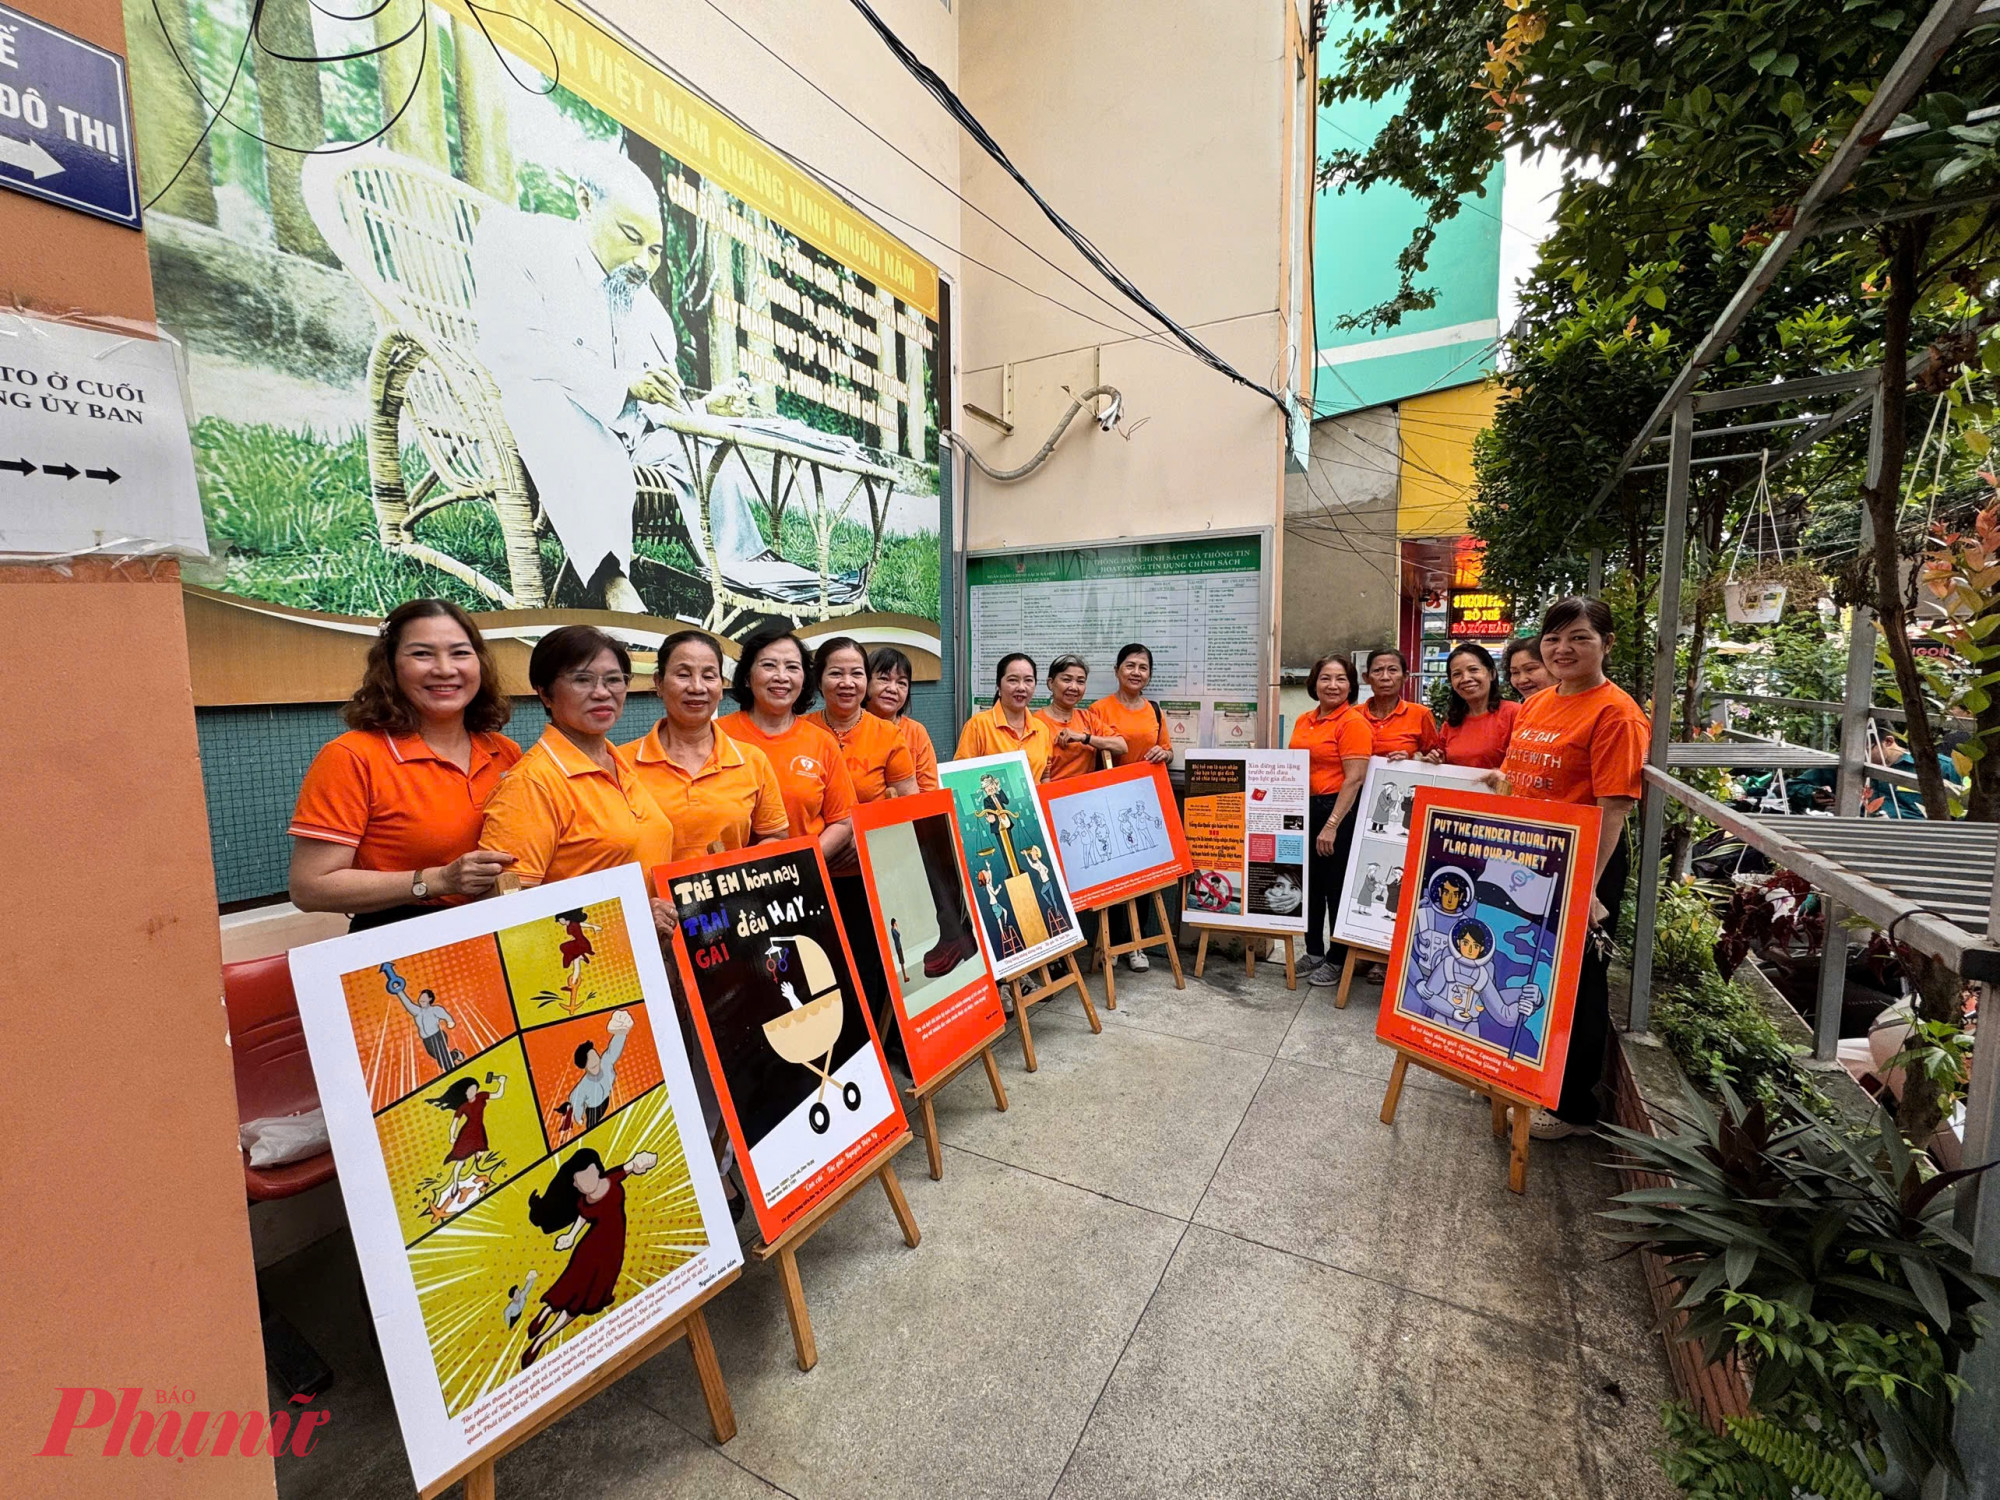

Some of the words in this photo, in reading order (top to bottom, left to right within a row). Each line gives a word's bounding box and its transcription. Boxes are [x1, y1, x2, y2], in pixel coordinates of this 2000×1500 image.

[58, 105, 119, 163] THỊ
[586, 42, 645, 112] VIỆT
[653, 90, 710, 157] NAM
[717, 136, 786, 209] QUANG
[789, 186, 831, 238] VINH
[834, 217, 881, 270] MUÔN
[884, 249, 915, 293] NĂM
[667, 173, 698, 216] CÁN
[47, 371, 69, 390] Ở
[39, 394, 80, 415] ỦY
[87, 403, 143, 424] BAN
[1137, 553, 1164, 563] CHÍNH
[1166, 551, 1188, 560] SÁCH
[1189, 551, 1202, 560] VÀ
[1203, 549, 1233, 559] THÔNG
[1235, 549, 1250, 557] TIN
[1163, 560, 1186, 570] DỤNG
[1188, 558, 1216, 568] CHÍNH
[1218, 556, 1241, 567] SÁCH
[1912, 647, 1950, 657] IGON
[1434, 818, 1452, 833] PUT
[1453, 820, 1471, 837] THE
[1472, 824, 1511, 844] GENDER
[1512, 830, 1565, 853] EQUALITY
[1443, 838, 1468, 856] FLAG
[1468, 843, 1482, 857] ON
[1483, 846, 1503, 861] OUR
[1504, 849, 1547, 871] PLANET
[673, 873, 714, 905] TRẺ
[717, 871, 740, 896] EM
[741, 868, 773, 892] hôm
[773, 863, 800, 886] nay
[737, 909, 769, 938] đều
